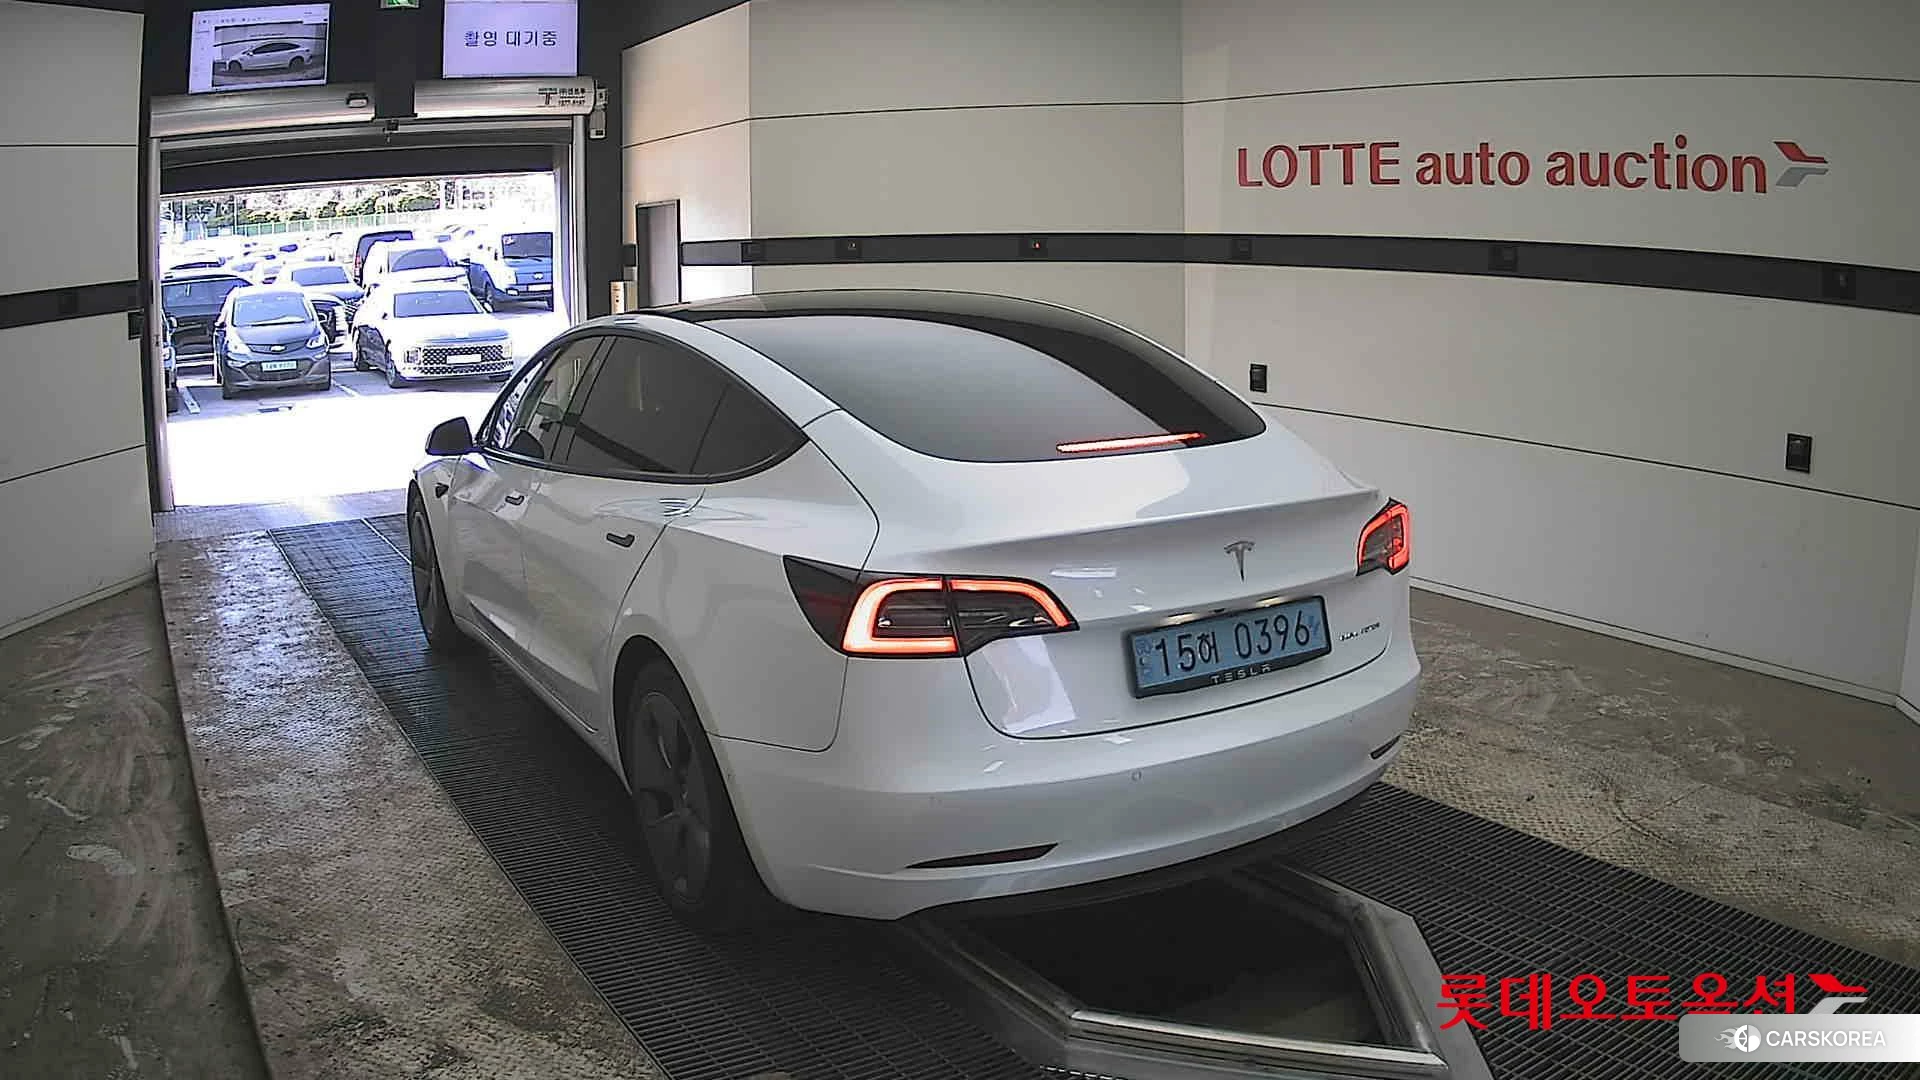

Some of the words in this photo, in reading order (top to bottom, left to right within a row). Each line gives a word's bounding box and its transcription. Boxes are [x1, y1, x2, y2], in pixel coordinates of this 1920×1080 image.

[505, 30, 558, 48] 대기중
[1238, 141, 1401, 188] LOTTE
[1415, 142, 1530, 186] auto
[1545, 133, 1768, 194] auction
[1155, 631, 1219, 676] 15허
[1233, 610, 1311, 659] 0396
[1211, 663, 1271, 684] TESLA
